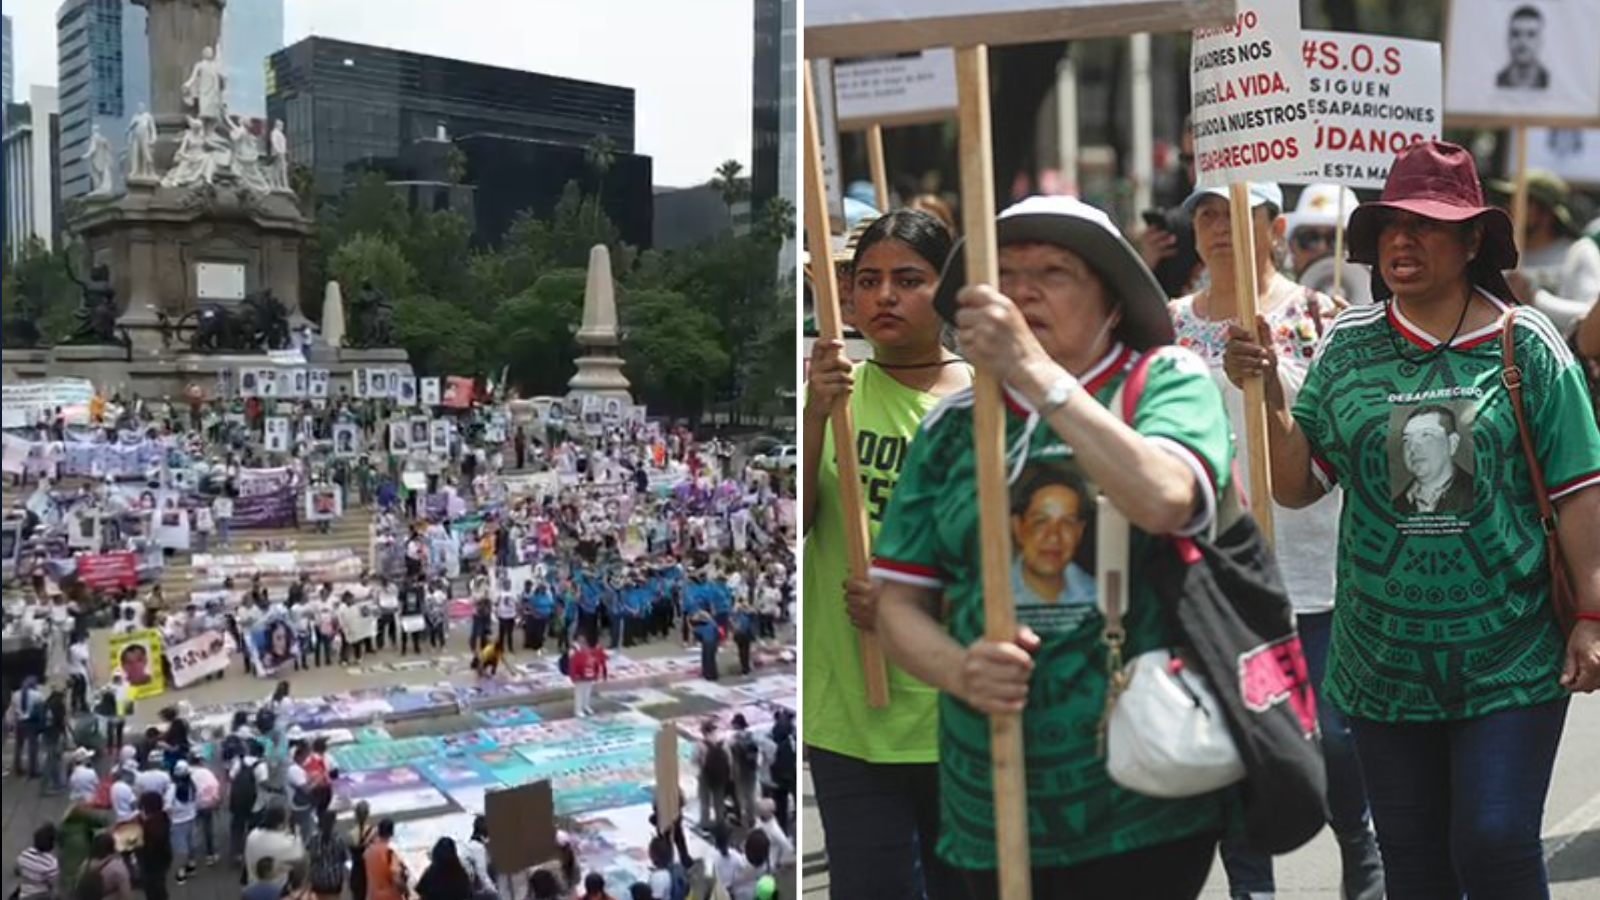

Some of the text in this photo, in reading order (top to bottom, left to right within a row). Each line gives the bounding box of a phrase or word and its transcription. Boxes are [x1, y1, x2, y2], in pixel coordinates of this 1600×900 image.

[1238, 40, 1272, 62] NOS
[1302, 40, 1402, 75] #S.O.S
[1216, 79, 1236, 103] LA
[1238, 71, 1290, 97] VIDA,
[1309, 77, 1390, 98] SIGUEN
[1227, 102, 1308, 132] NUESTROS
[1307, 98, 1436, 123] ESAPARICIONES
[1323, 162, 1392, 180] ESTA MA
[1387, 386, 1483, 402] DESAPARECIDO
